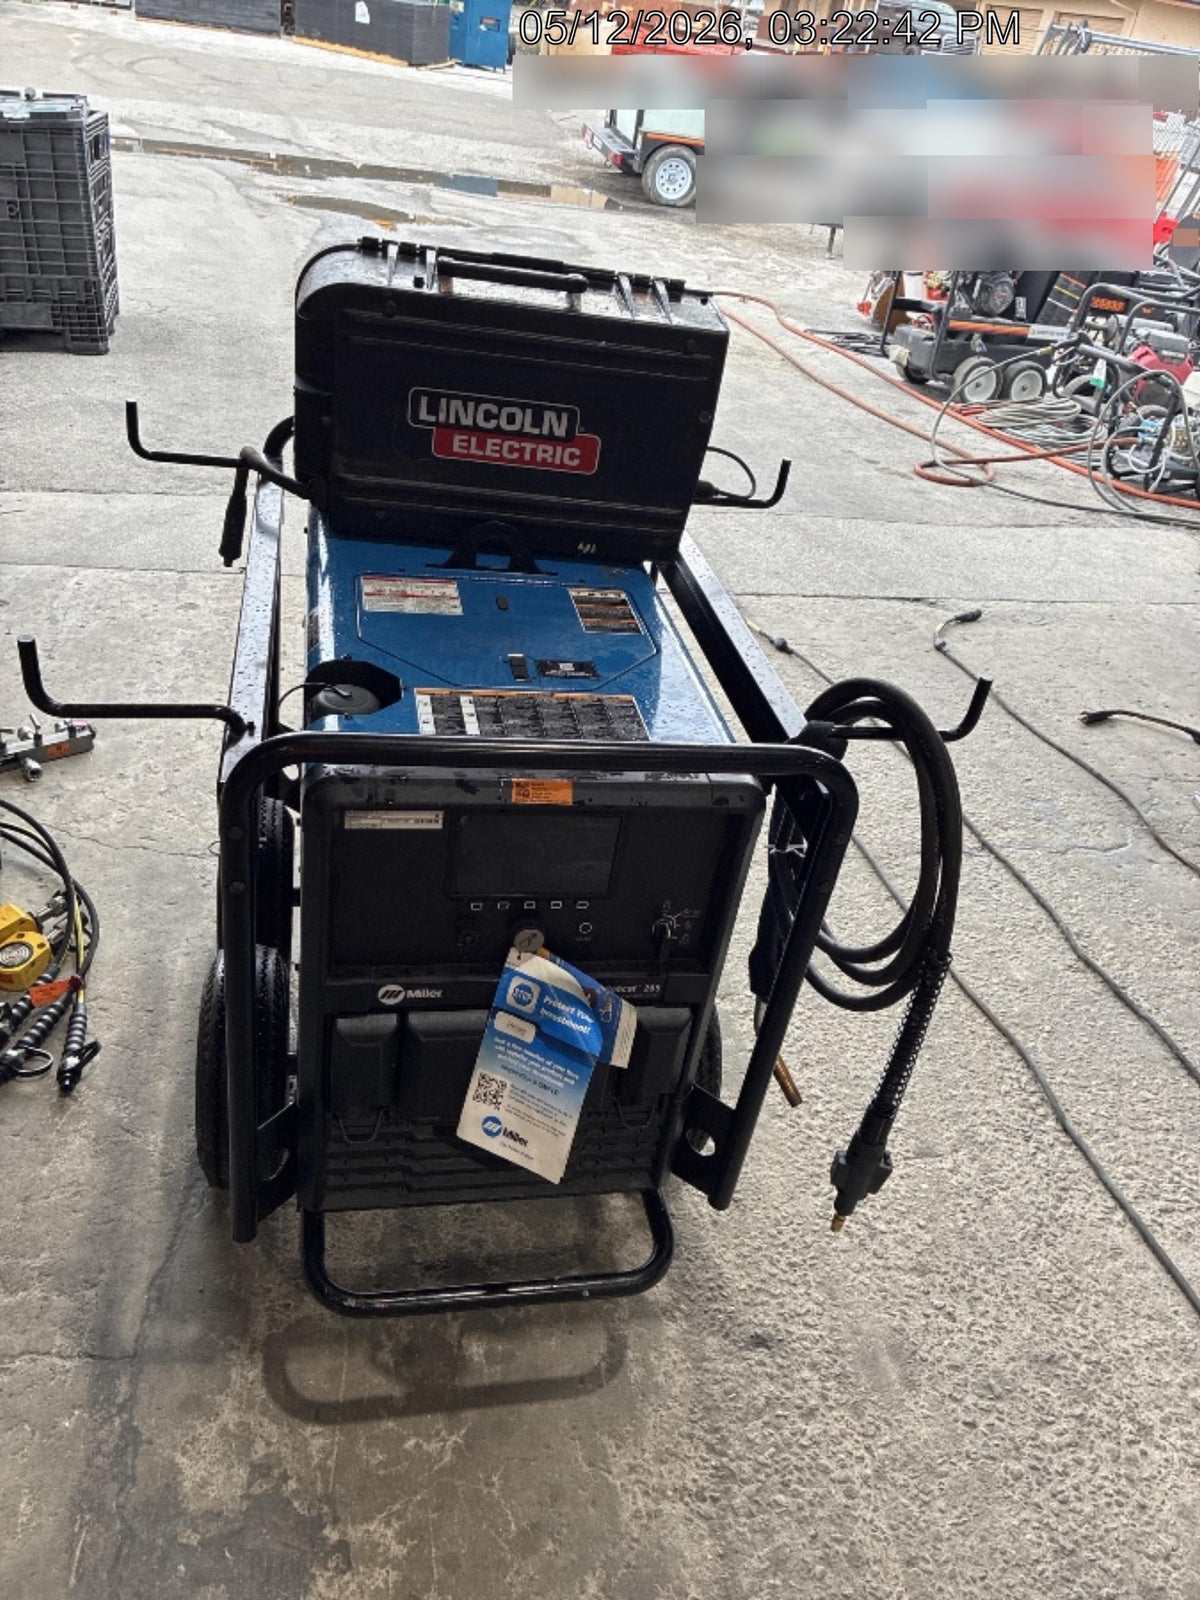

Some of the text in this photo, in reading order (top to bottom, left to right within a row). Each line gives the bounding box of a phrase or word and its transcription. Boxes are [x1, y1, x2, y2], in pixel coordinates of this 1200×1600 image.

[418, 396, 568, 437] LINCOLN
[452, 434, 581, 467] ELECTRIC
[406, 988, 443, 999] Miller
[543, 995, 576, 1014] Protect
